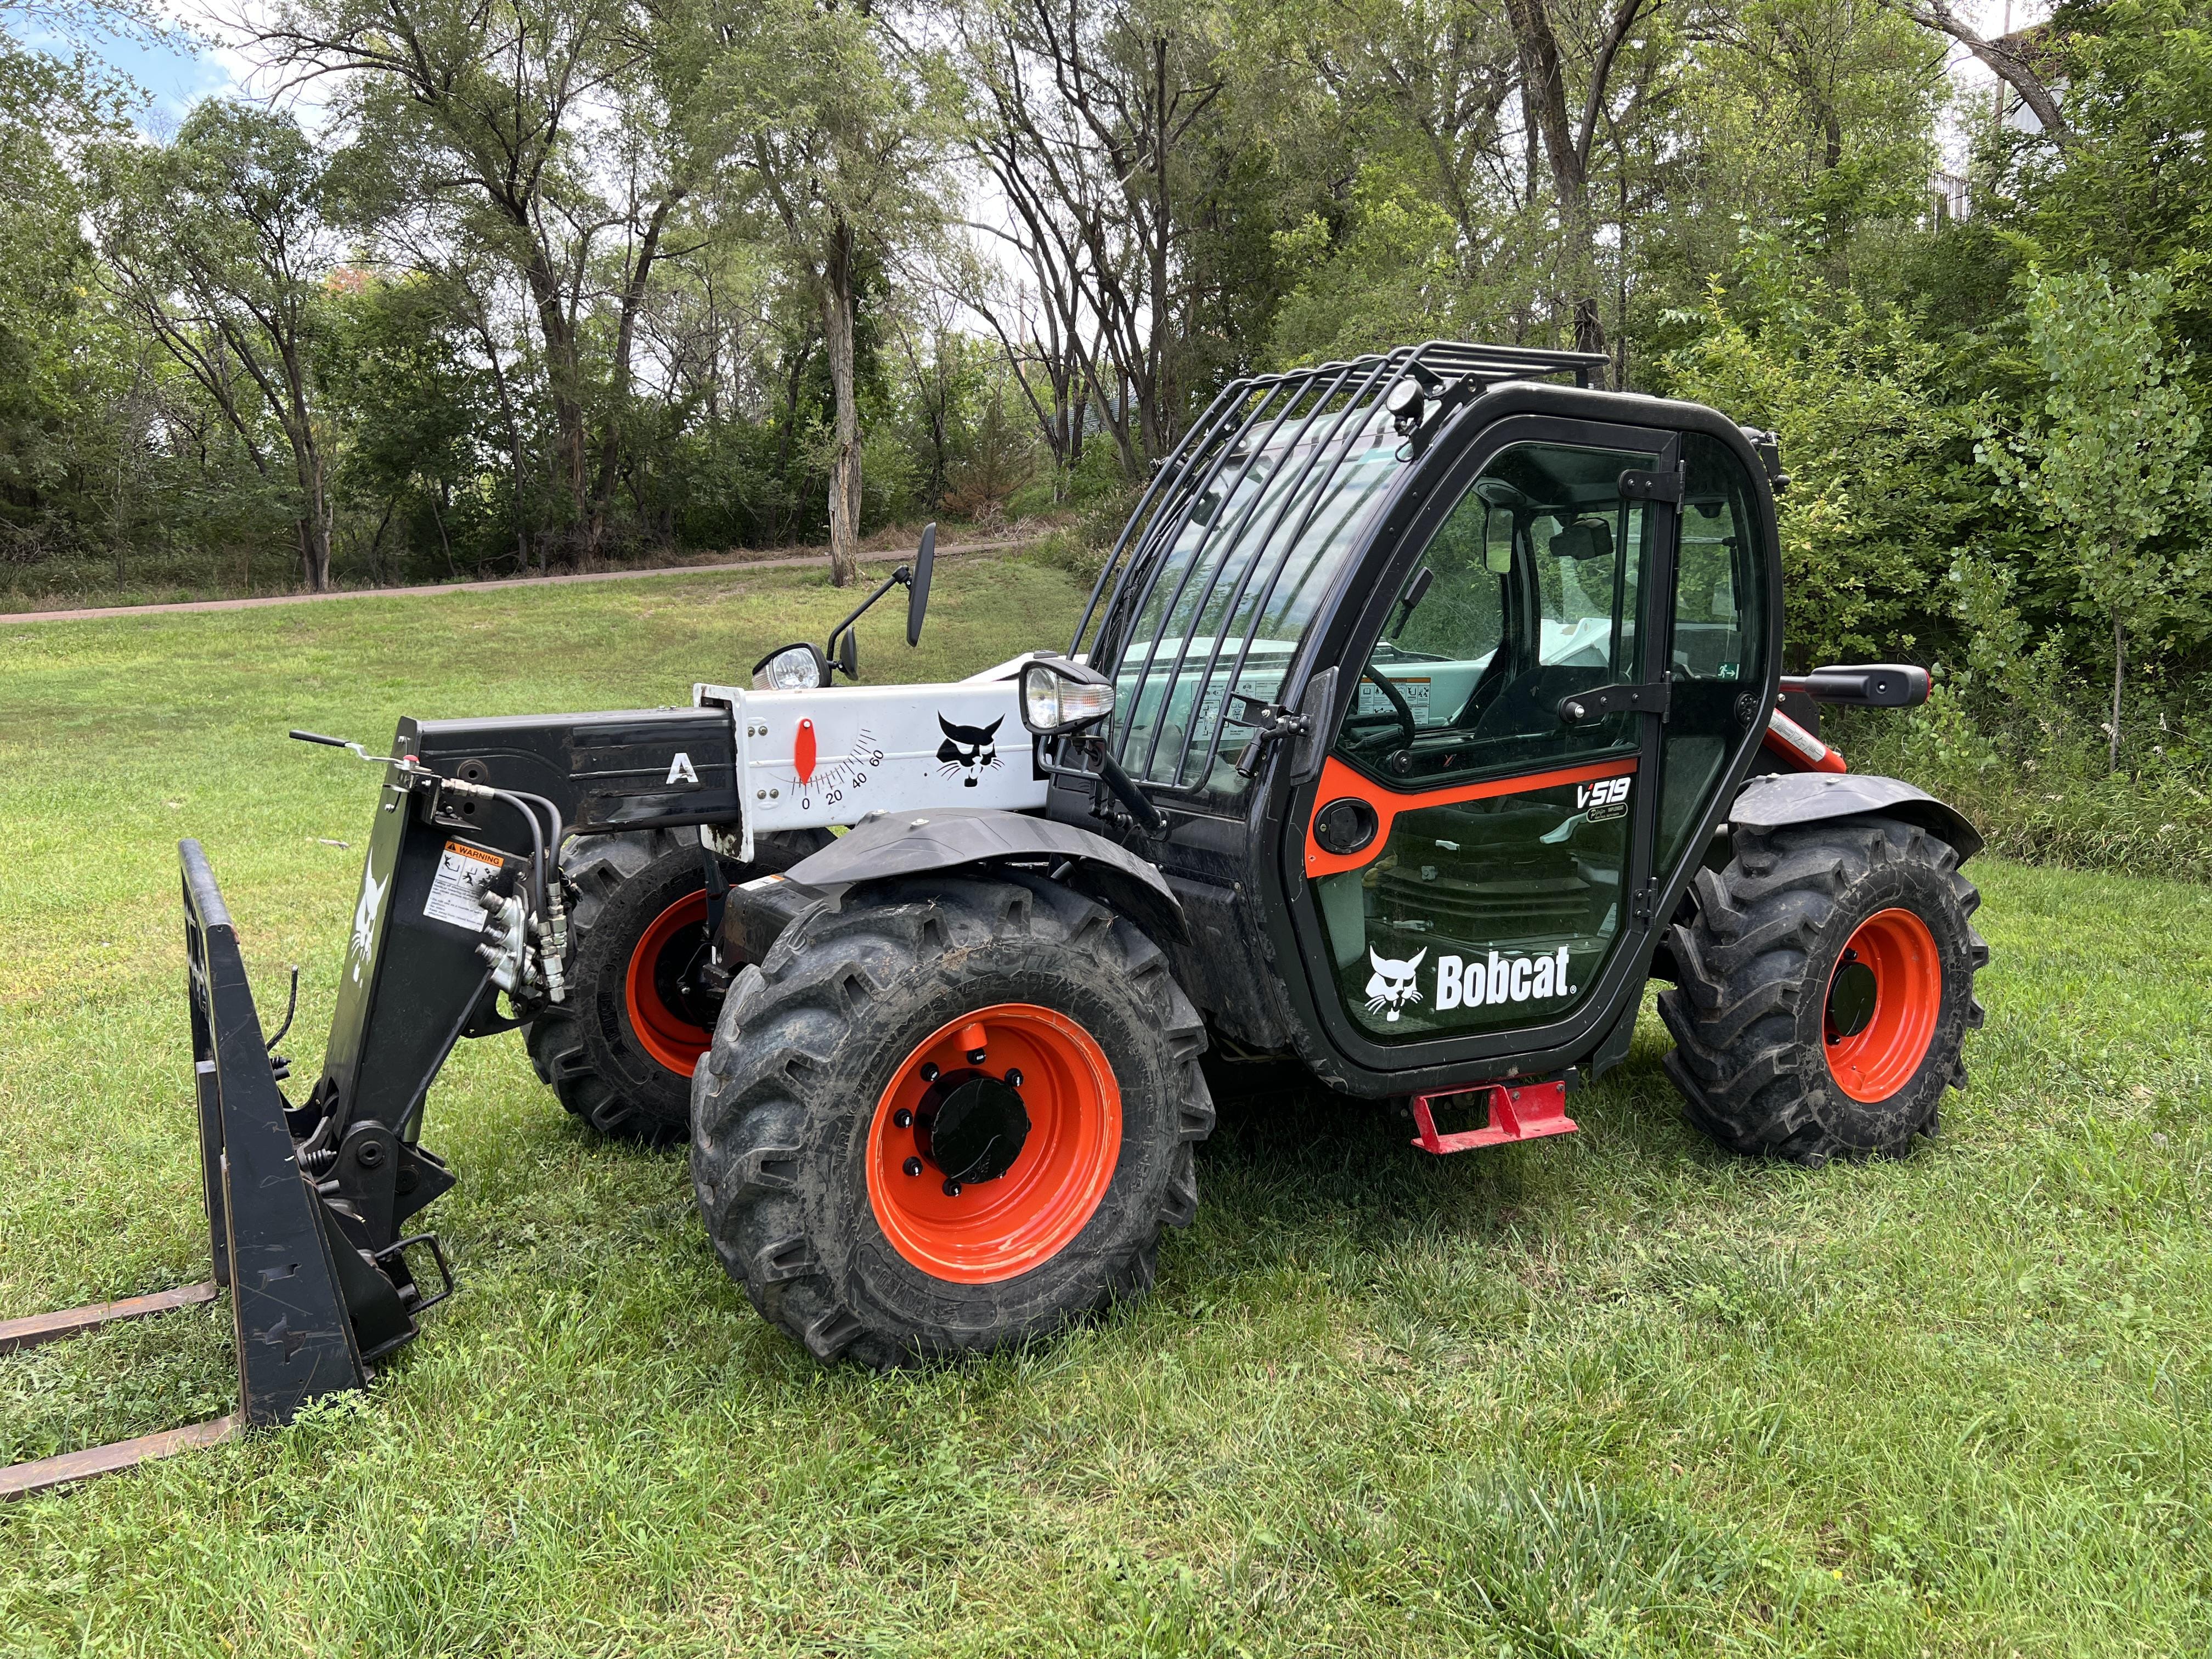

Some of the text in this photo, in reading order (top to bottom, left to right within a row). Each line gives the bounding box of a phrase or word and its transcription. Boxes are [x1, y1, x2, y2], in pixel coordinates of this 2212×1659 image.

[869, 749, 884, 767] 60
[665, 752, 699, 785] A
[853, 772, 867, 788] 40
[826, 789, 842, 805] 20
[1577, 777, 1630, 809] V519
[802, 798, 810, 810] 0
[459, 846, 500, 865] WARNING
[1436, 946, 1570, 1011] Bobcat
